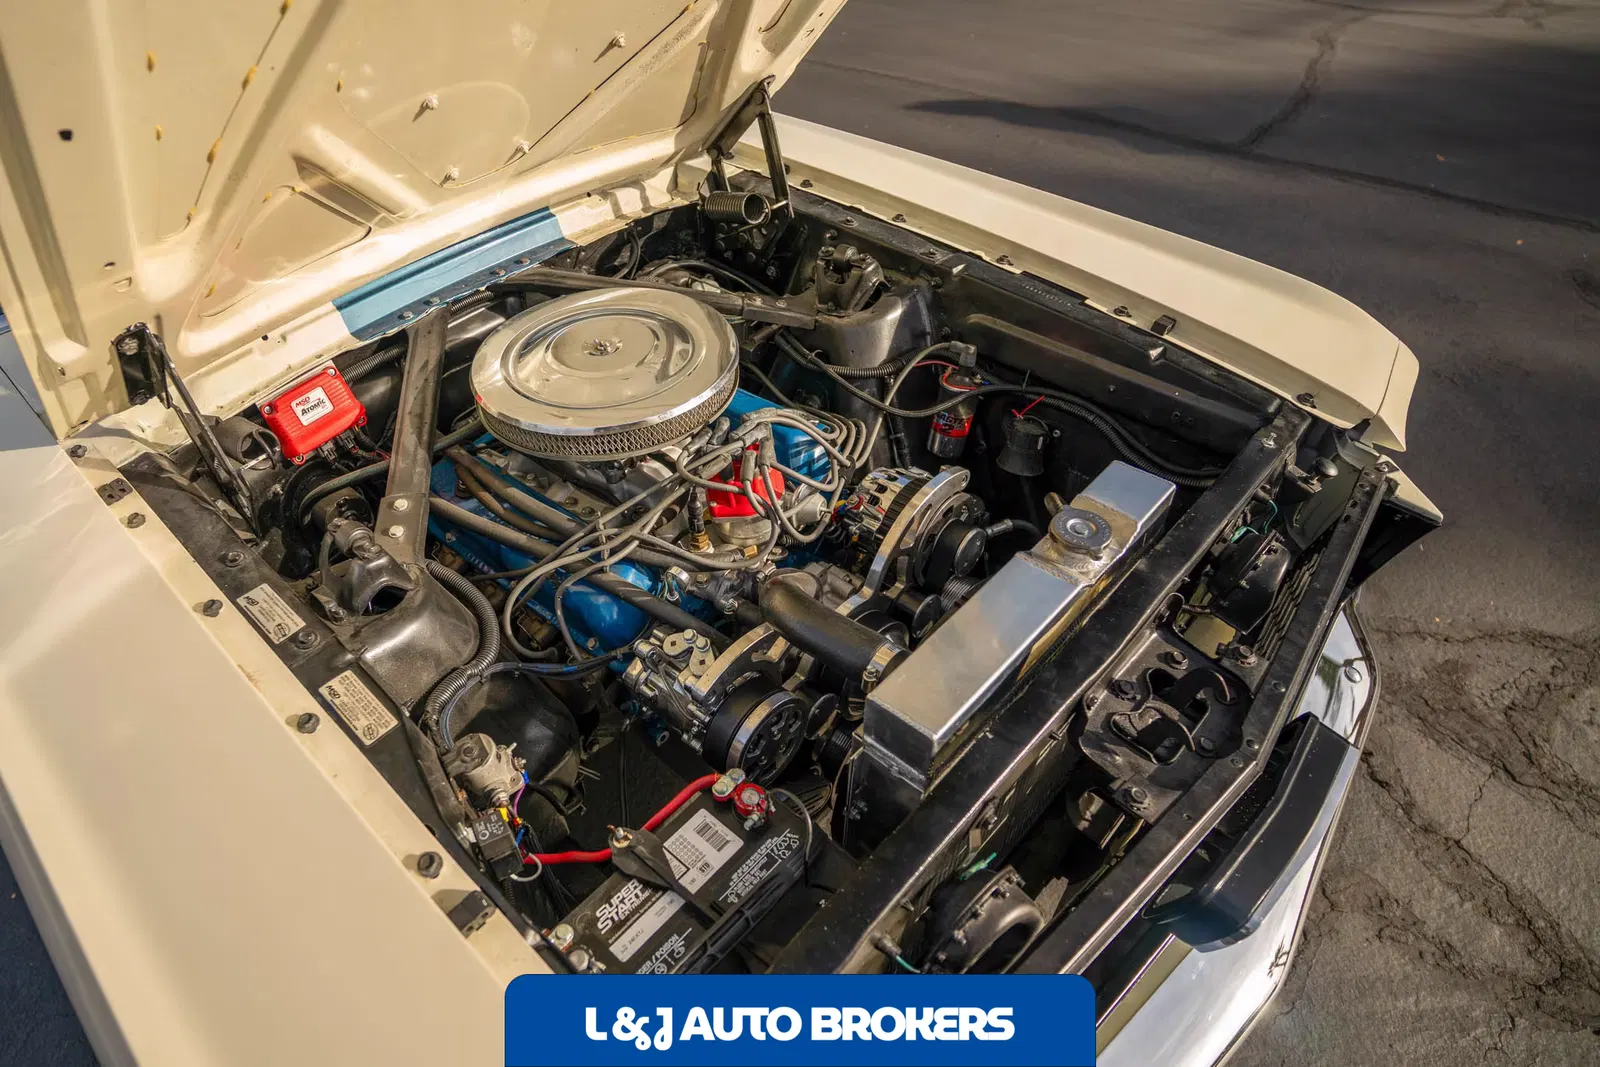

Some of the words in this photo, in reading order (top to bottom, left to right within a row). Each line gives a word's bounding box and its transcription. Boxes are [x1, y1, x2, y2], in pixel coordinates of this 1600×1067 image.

[296, 396, 310, 408] MSD
[243, 596, 260, 605] MSD
[326, 685, 341, 699] MSD
[596, 878, 640, 917] SUPER
[597, 884, 644, 934] START
[656, 933, 679, 958] POISON
